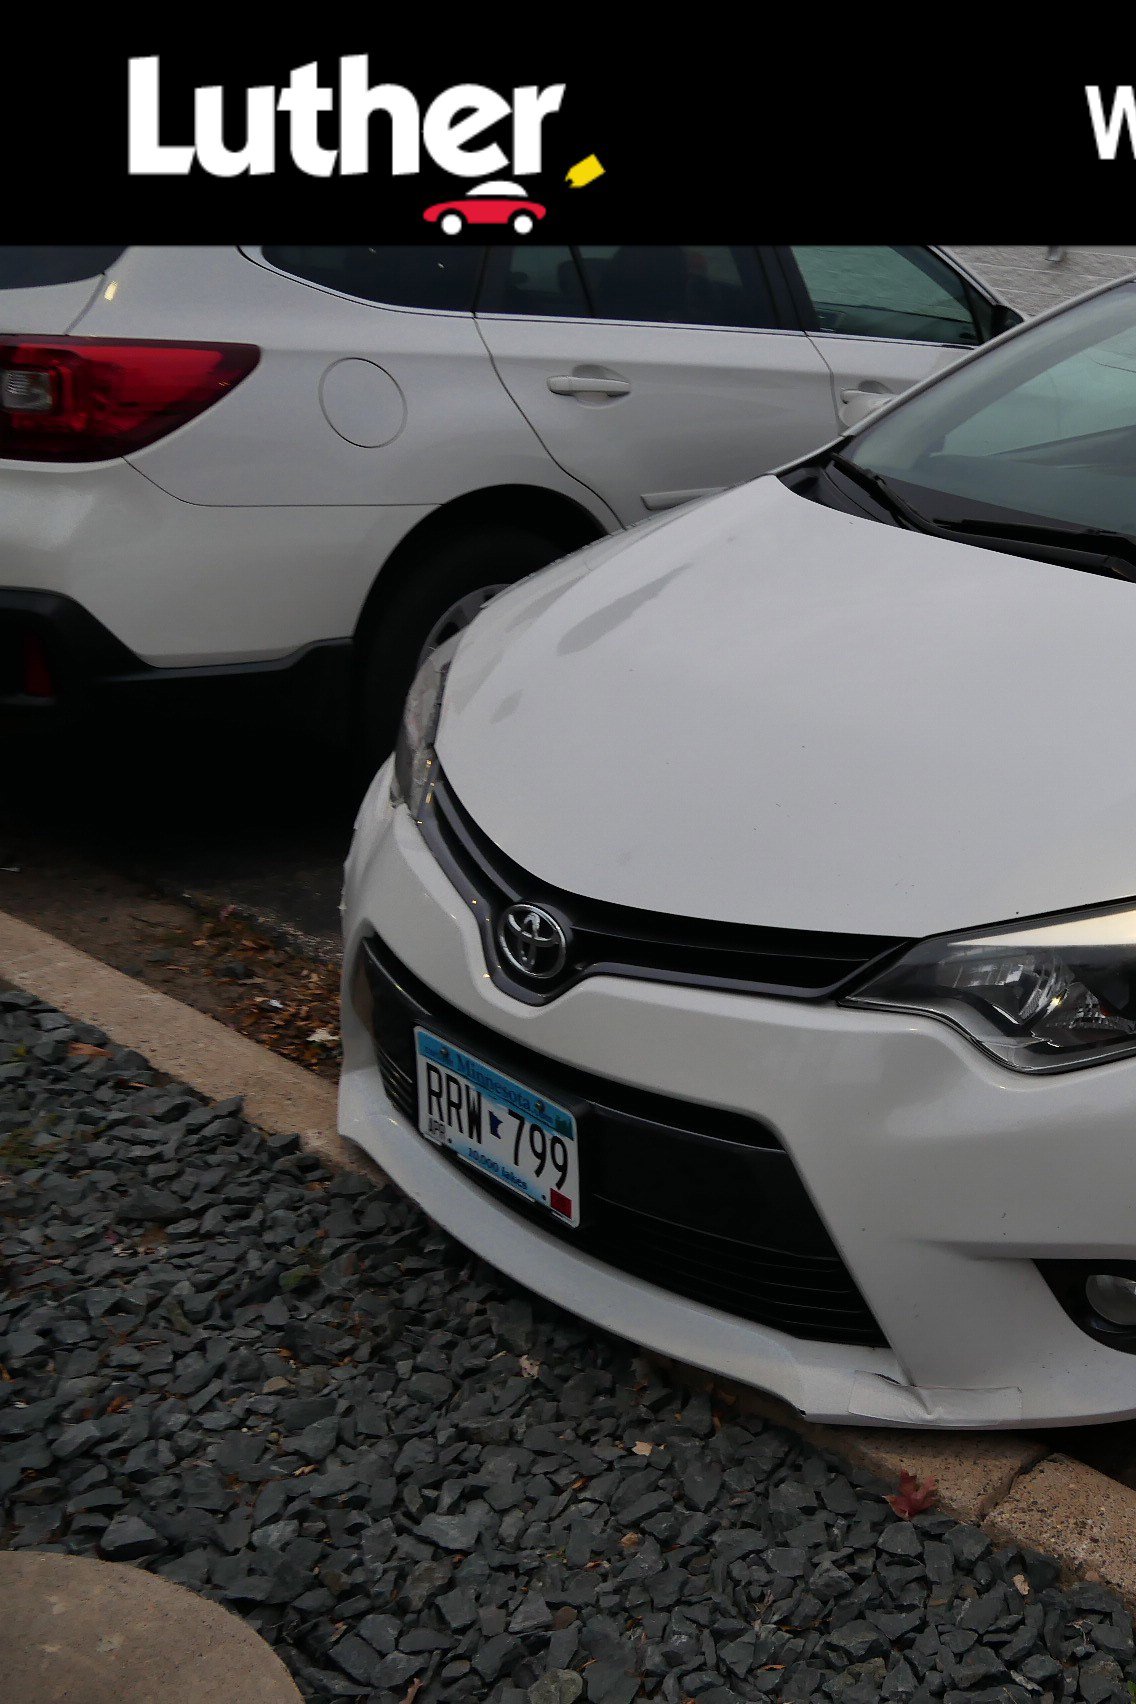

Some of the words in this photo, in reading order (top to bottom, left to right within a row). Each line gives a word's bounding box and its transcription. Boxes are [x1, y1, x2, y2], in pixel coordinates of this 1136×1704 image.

[426, 1061, 483, 1144] RRW
[508, 1108, 568, 1191] 799
[454, 1052, 531, 1110] Minnesota
